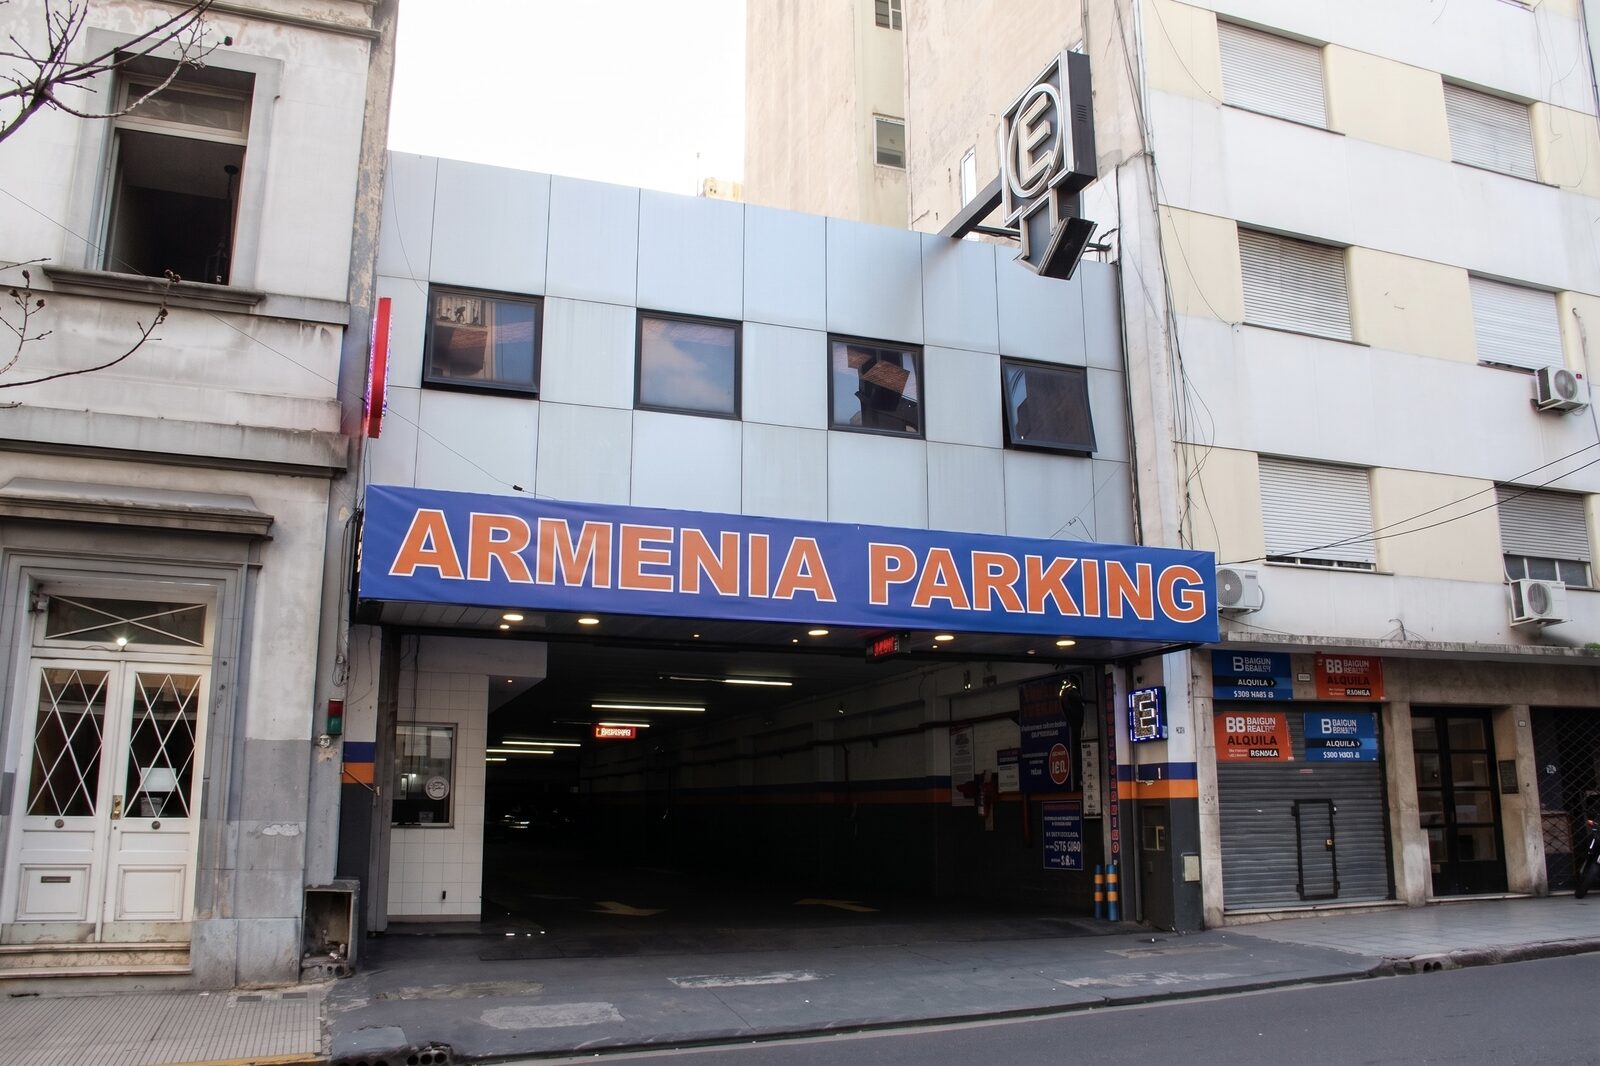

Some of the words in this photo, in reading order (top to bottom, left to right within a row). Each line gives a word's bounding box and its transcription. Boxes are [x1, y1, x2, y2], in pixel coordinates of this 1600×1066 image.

[388, 507, 837, 604] ARMENIA
[868, 542, 1207, 624] PARKING
[1326, 659, 1343, 674] BB
[1237, 678, 1268, 686] ALQUILA
[1327, 675, 1370, 685] ALQUILA
[1226, 717, 1246, 733] BB
[1246, 717, 1276, 725] BAIGUN
[1321, 718, 1332, 734] B
[1227, 735, 1277, 745] ALQUILA
